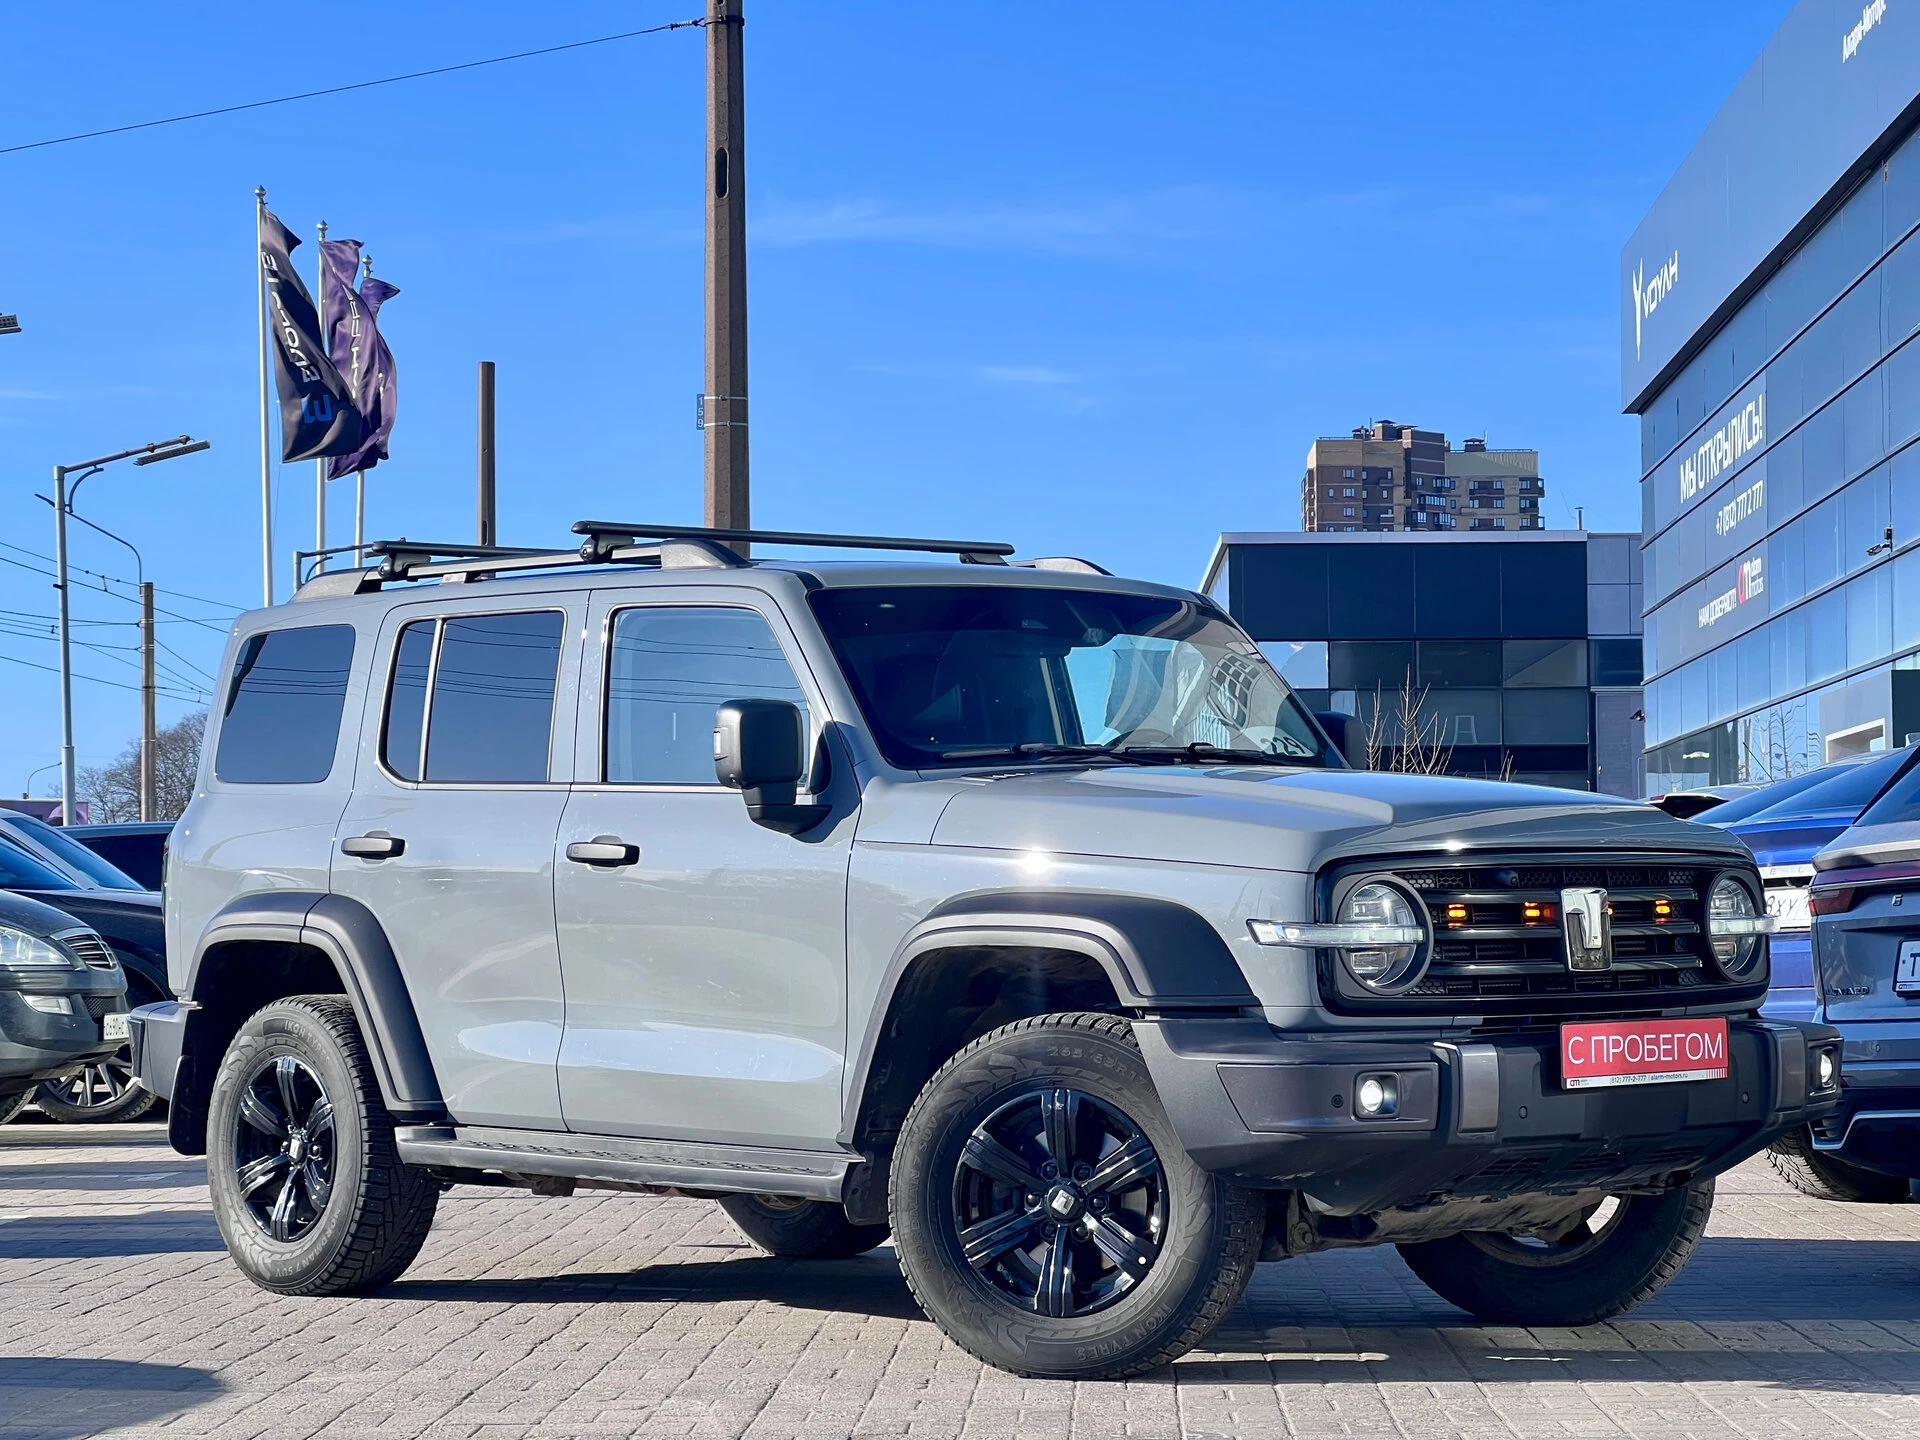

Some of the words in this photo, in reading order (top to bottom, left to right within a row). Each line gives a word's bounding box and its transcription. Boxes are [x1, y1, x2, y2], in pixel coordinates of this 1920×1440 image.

[1642, 249, 1678, 319] VOYAH
[1680, 452, 1697, 504] МЫ
[1697, 394, 1763, 490] ОТКРЫЛИСЬ!
[1715, 510, 1723, 536] +7
[1736, 491, 1747, 522] 777
[1747, 488, 1752, 515] 2
[1752, 479, 1764, 512] 777
[1567, 1036, 1585, 1065] С
[1591, 1032, 1723, 1064] ПРОБЕГОМ
